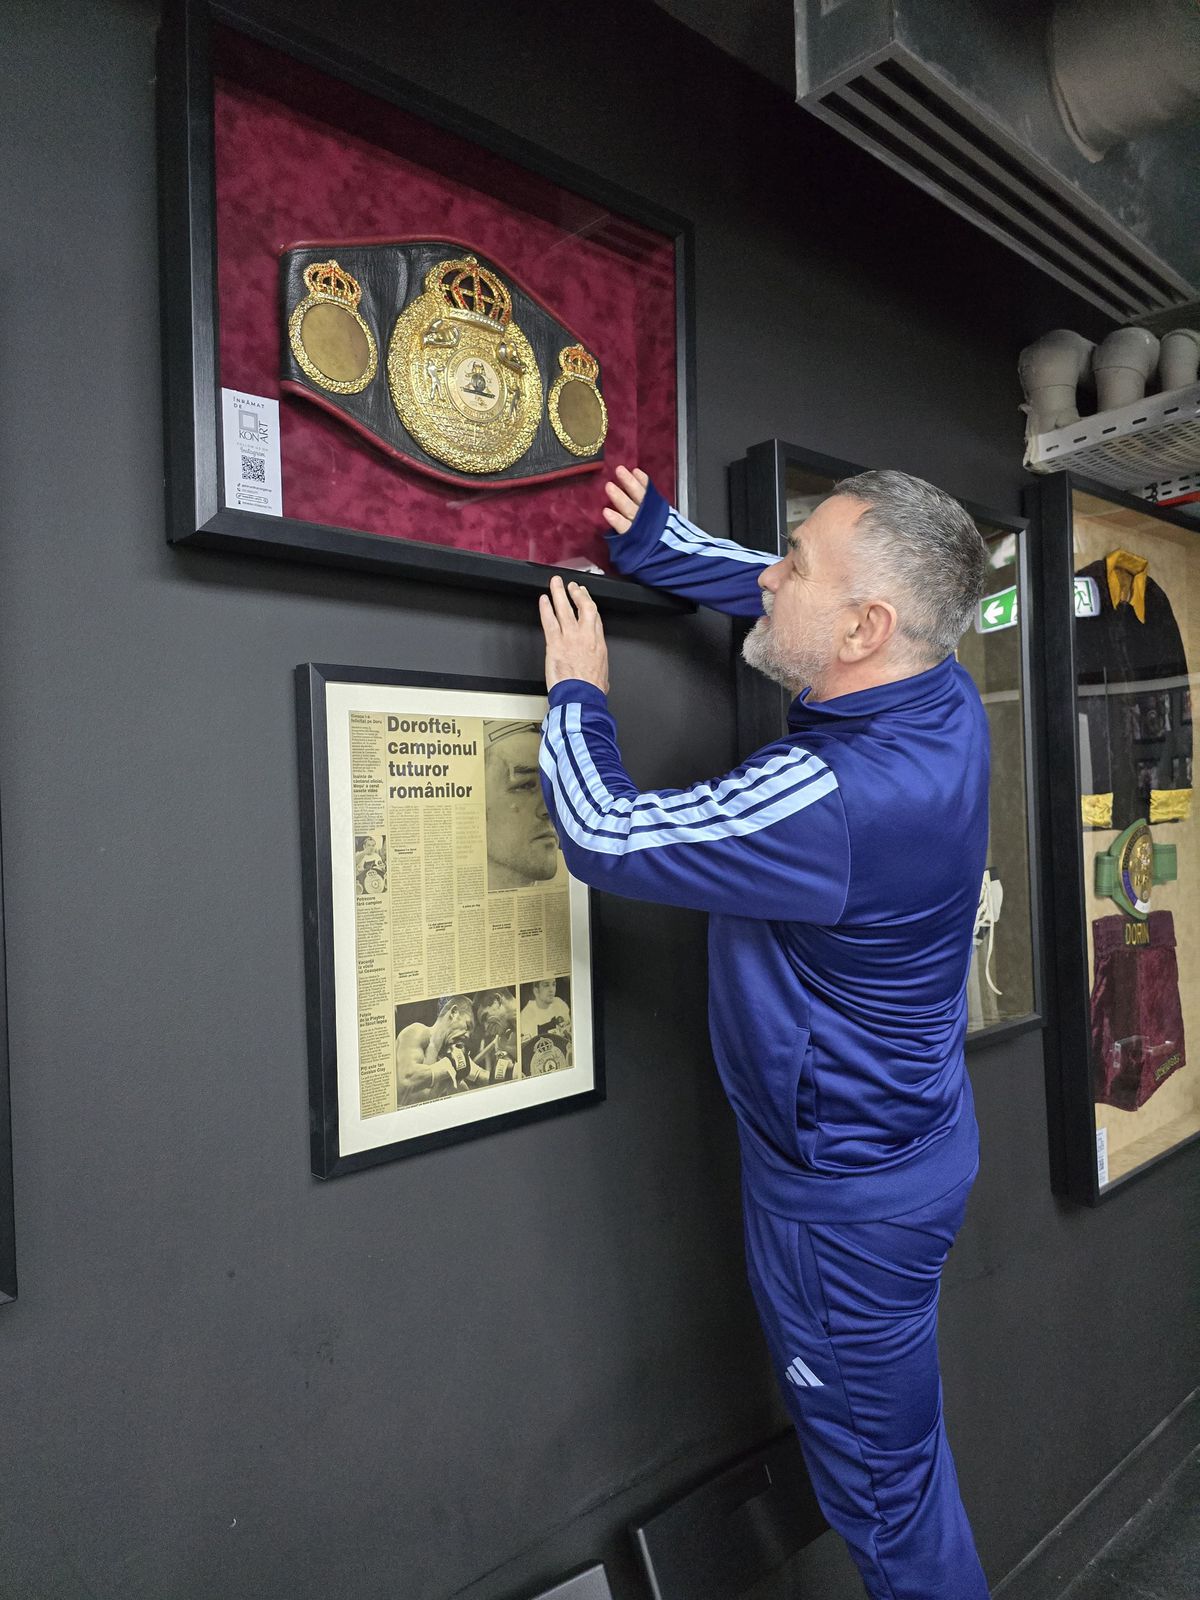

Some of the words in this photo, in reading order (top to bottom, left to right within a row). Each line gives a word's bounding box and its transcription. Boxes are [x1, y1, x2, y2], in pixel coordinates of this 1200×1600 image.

[239, 430, 260, 442] KON
[258, 420, 269, 444] ART
[387, 716, 461, 737] Doroftei,
[387, 740, 477, 759] campionul
[388, 761, 449, 776] tuturor
[389, 781, 473, 798] românilor
[1125, 923, 1150, 945] DORIN
